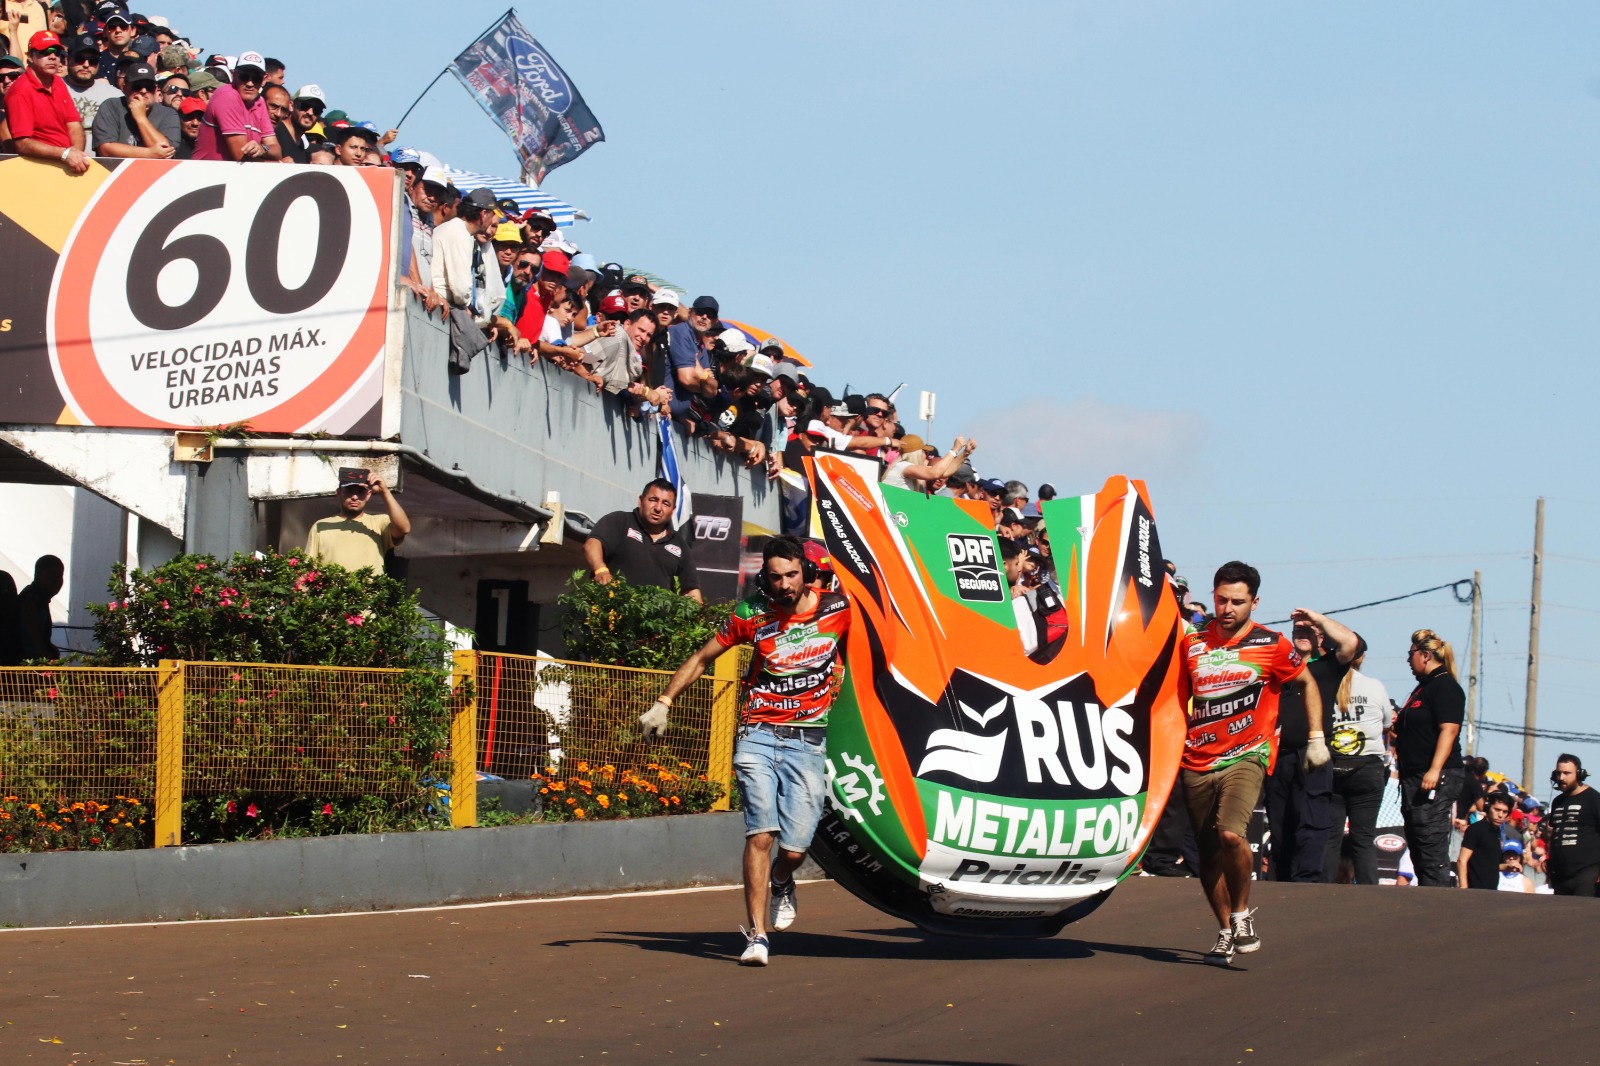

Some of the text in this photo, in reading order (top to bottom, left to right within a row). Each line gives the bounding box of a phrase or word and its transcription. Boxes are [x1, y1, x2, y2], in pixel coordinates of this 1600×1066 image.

[515, 52, 564, 104] Ford
[584, 127, 602, 143] 2
[126, 171, 351, 331] 60
[130, 327, 327, 371] VELOCIDAD MÁX.
[166, 356, 282, 388] EN ZONAS
[168, 378, 279, 410] URBANAS
[694, 515, 732, 541] TC
[827, 509, 871, 574] GRÚAS VAZQUEZ
[1139, 515, 1150, 553] VAZQUEZ
[949, 538, 995, 564] DRF
[959, 578, 999, 591] SEGUROS
[830, 601, 845, 611] RUS
[775, 624, 819, 647] METALFOR
[767, 639, 834, 666] Castellano
[1198, 652, 1239, 665] METALFOR
[1193, 669, 1253, 688] Castellano
[1227, 714, 1253, 733] AMA
[1013, 696, 1144, 796] RUS
[933, 790, 1140, 856] METALFOR
[948, 858, 1102, 885] Prialis
[953, 907, 1047, 917] COMBUSTIBLES
